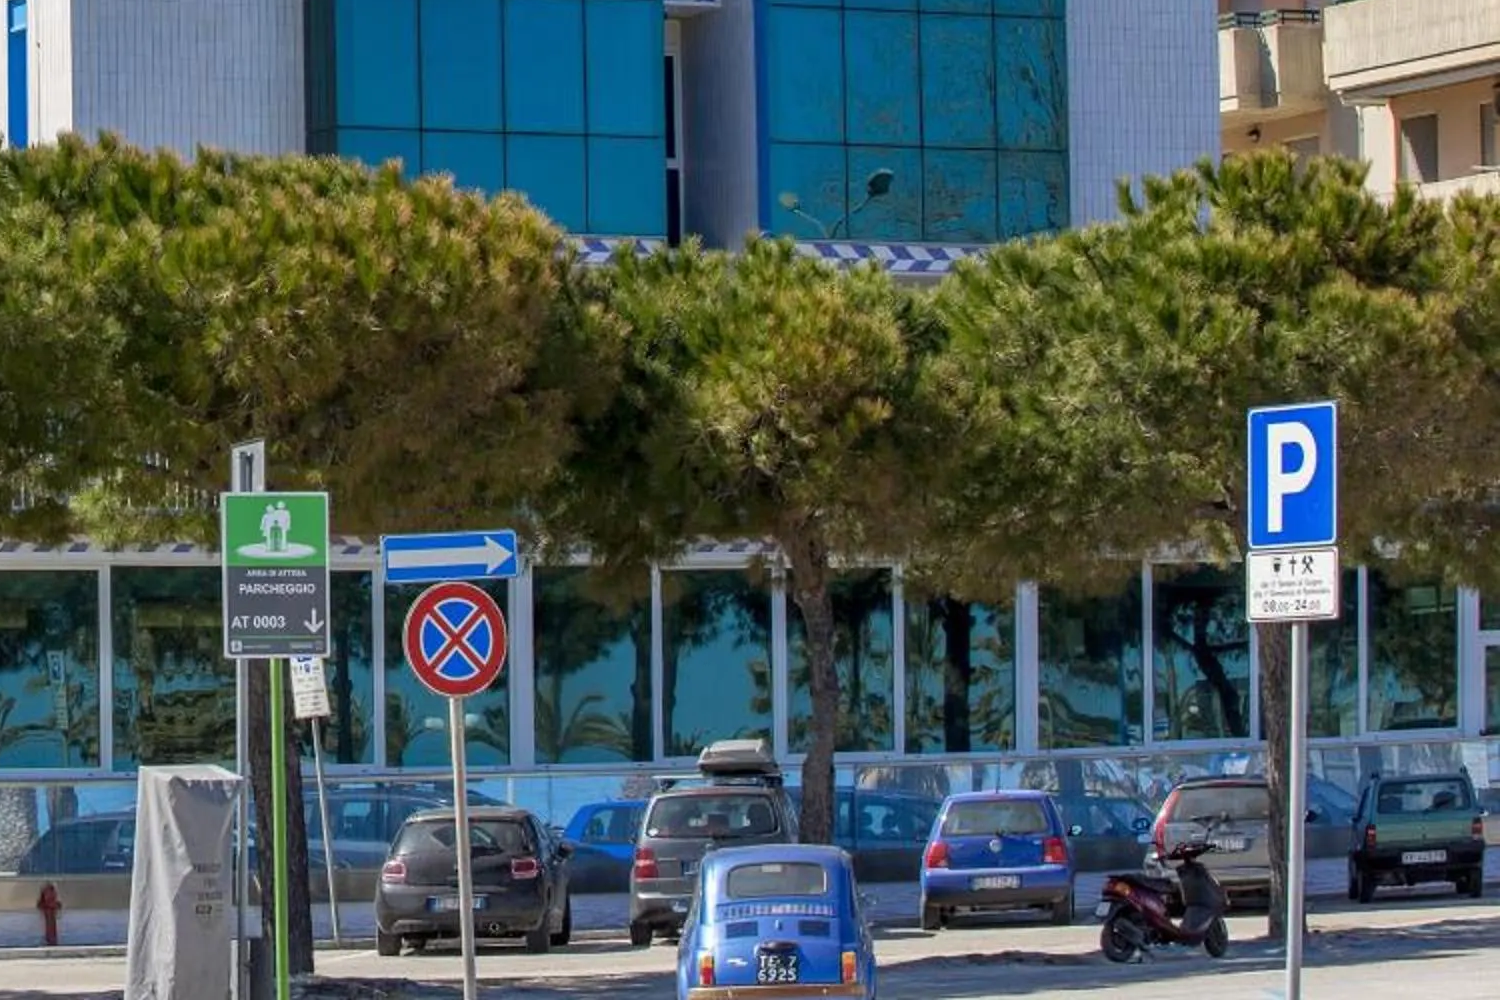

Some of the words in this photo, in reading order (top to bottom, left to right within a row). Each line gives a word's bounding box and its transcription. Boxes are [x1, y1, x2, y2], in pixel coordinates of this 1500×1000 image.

[1267, 421, 1317, 533] P
[239, 583, 316, 595] PARCHEGGIO
[231, 616, 250, 629] AT
[253, 616, 286, 629] 0003
[760, 955, 776, 969] TE
[789, 956, 797, 968] 7
